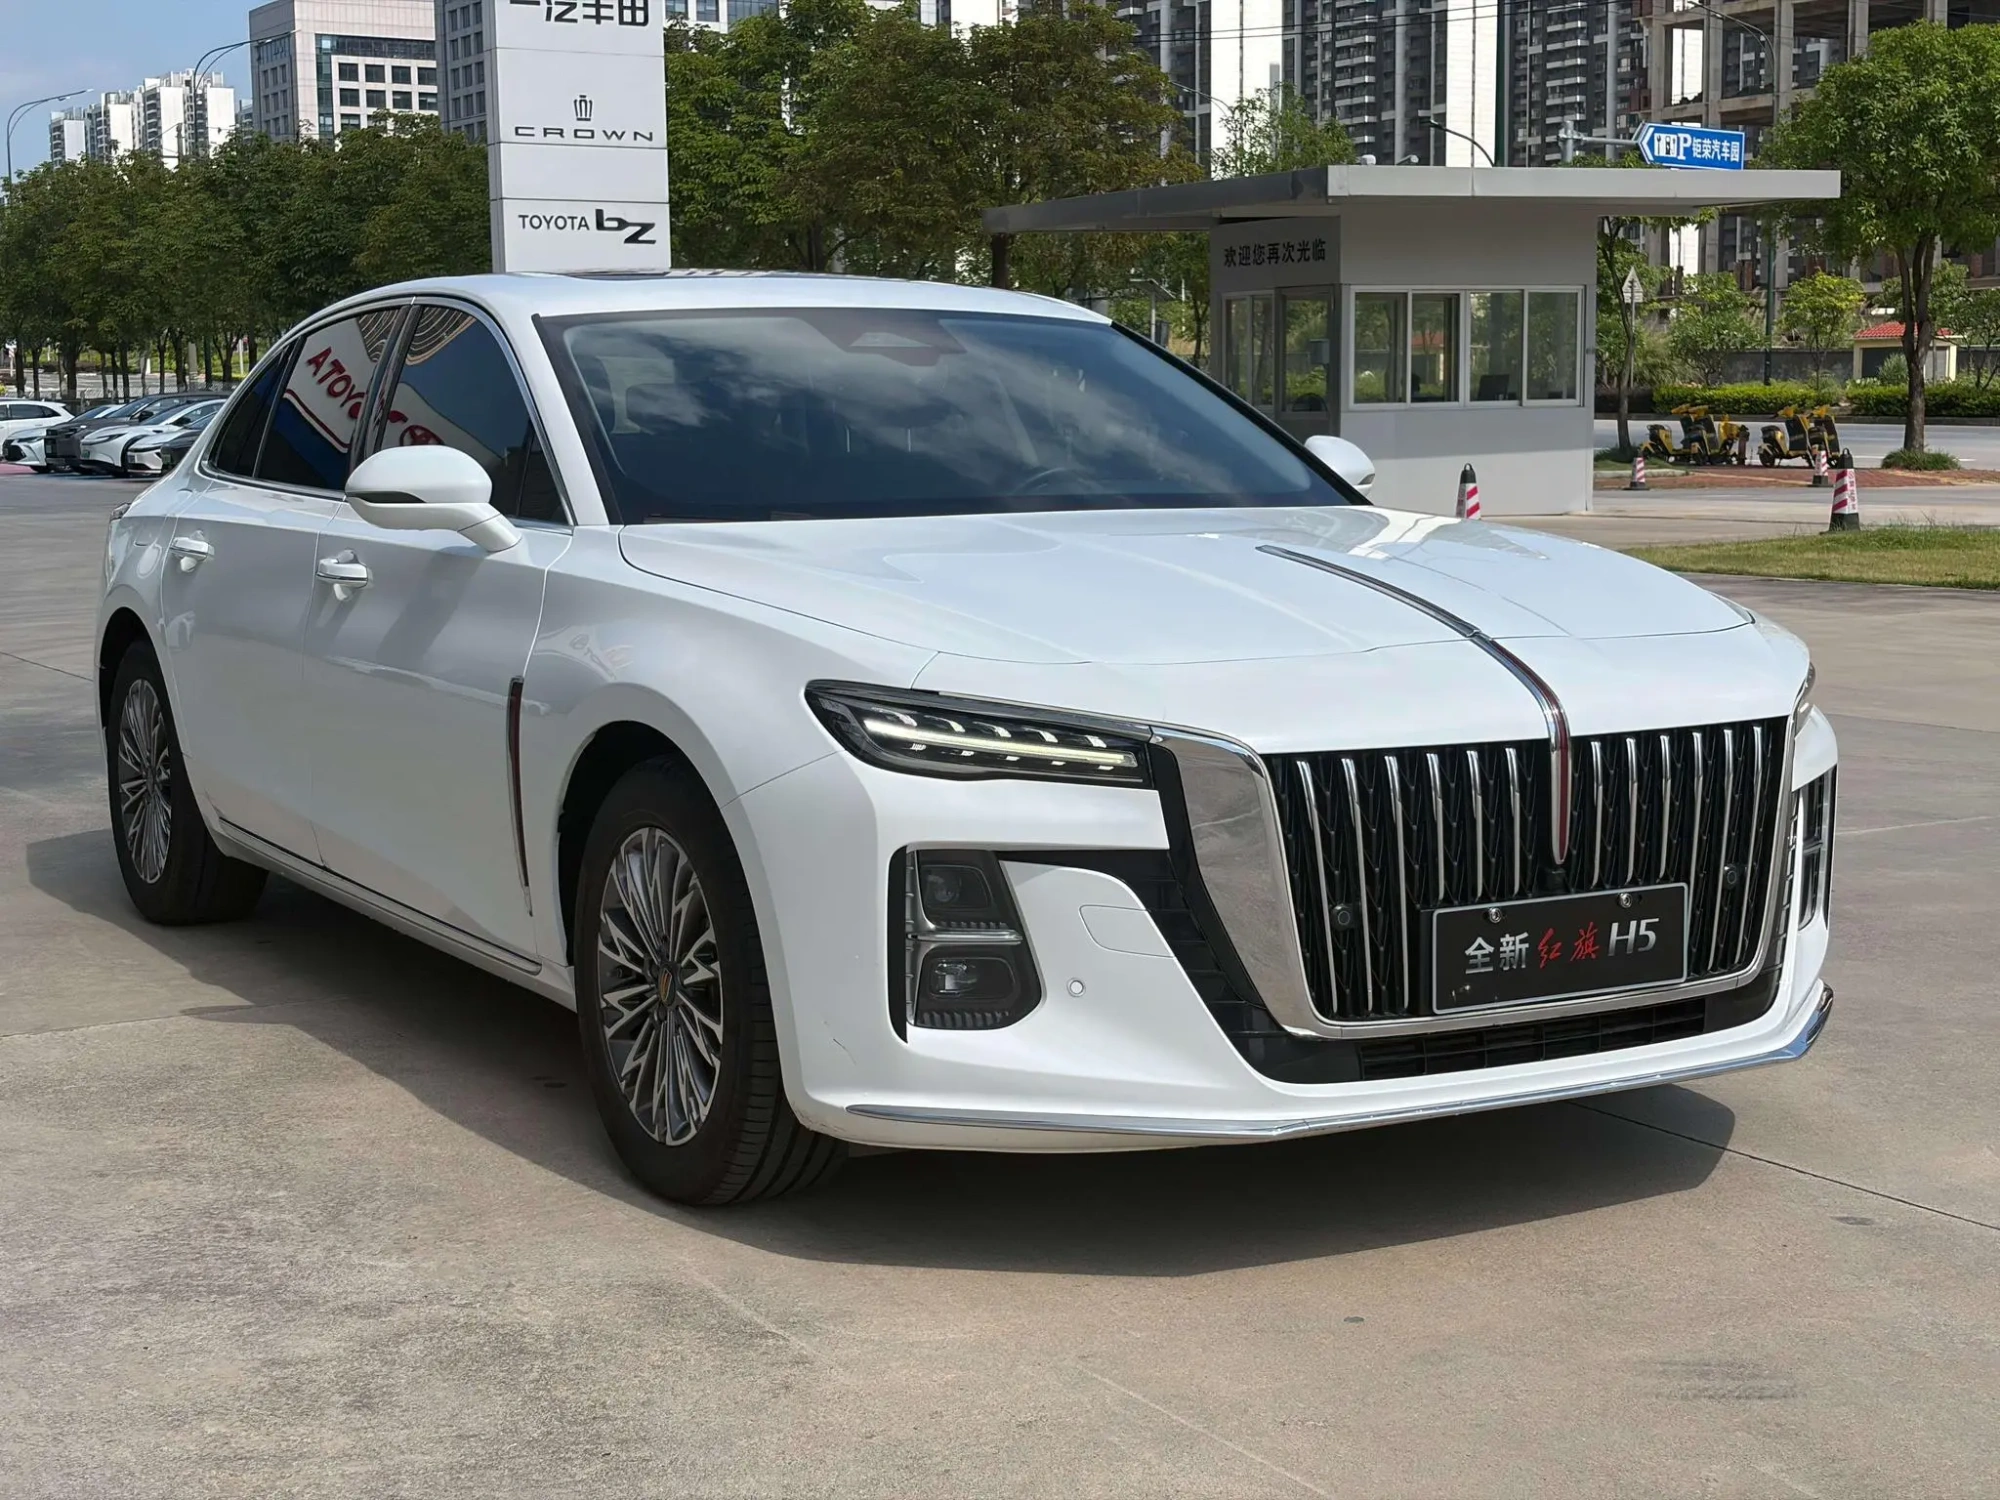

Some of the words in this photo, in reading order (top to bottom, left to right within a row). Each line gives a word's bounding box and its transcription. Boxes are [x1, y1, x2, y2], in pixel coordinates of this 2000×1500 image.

[515, 126, 653, 142] CROWN
[1677, 133, 1692, 160] P
[518, 214, 590, 231] TOYOTA
[1224, 238, 1326, 268] 欢迎您再次光临
[1465, 931, 1530, 975] 全新
[1538, 921, 1600, 970] 红旗
[1608, 917, 1660, 957] H5
